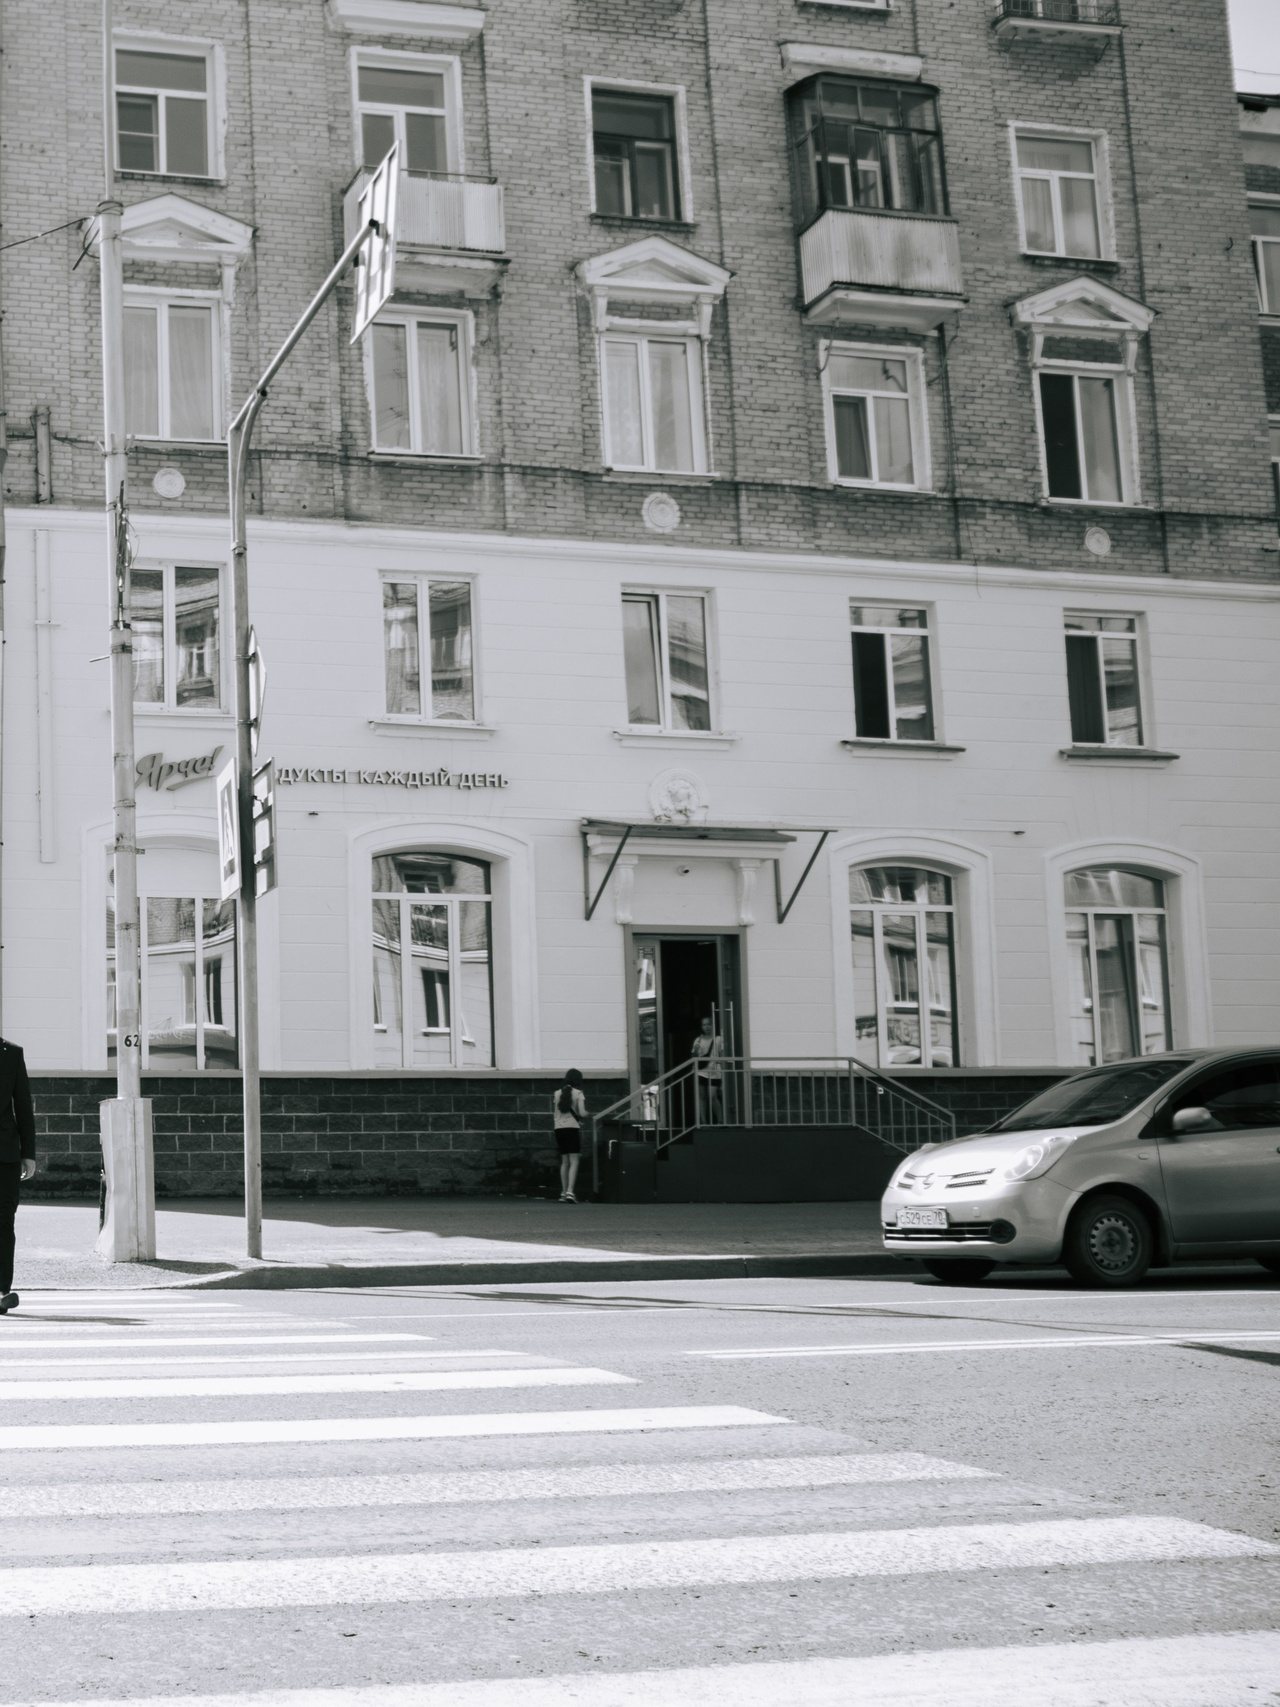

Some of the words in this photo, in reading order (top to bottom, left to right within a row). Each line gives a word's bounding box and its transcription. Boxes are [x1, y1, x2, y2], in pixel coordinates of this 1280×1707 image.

[135, 745, 224, 791] Ярче!
[273, 767, 348, 785] ДУКТЫ
[358, 767, 453, 788] КАЖДЫЙ
[458, 772, 510, 789] ДЕНЬ
[124, 1034, 139, 1047] 62
